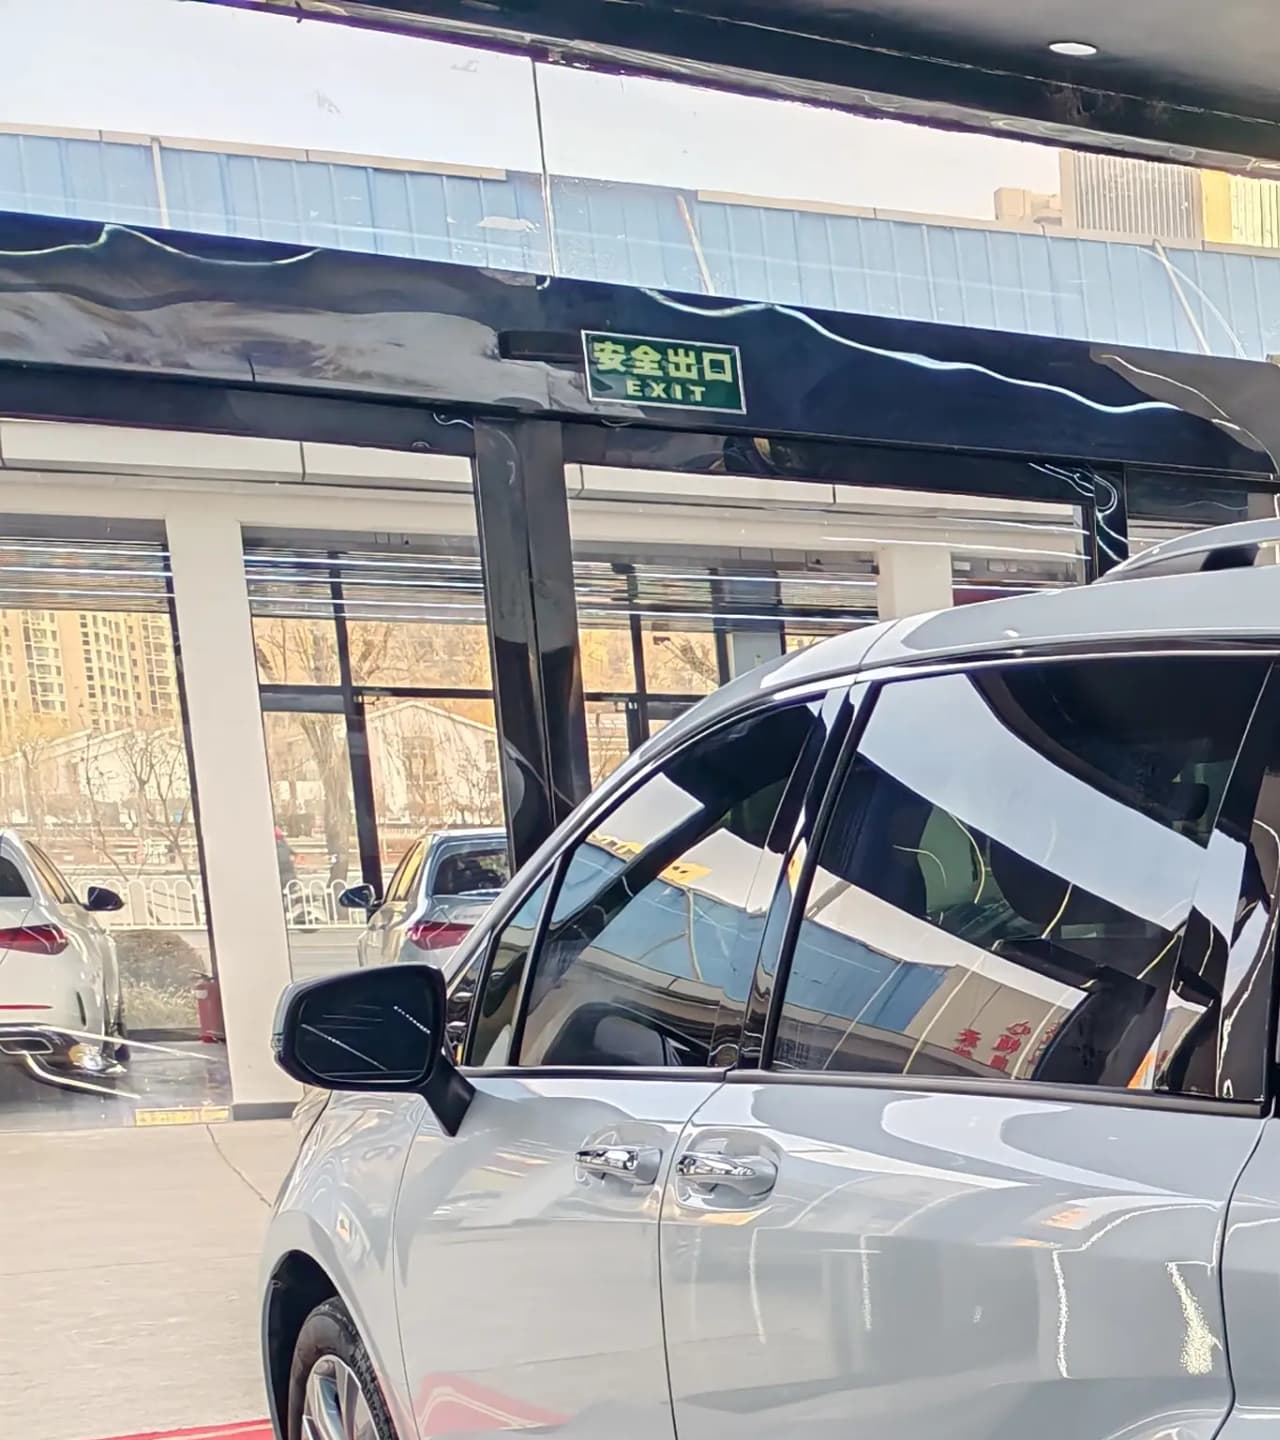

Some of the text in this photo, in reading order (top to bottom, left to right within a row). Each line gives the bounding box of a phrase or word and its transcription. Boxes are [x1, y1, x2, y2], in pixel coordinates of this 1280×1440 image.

[593, 341, 733, 383] 安全出口
[625, 379, 706, 402] EXIT
